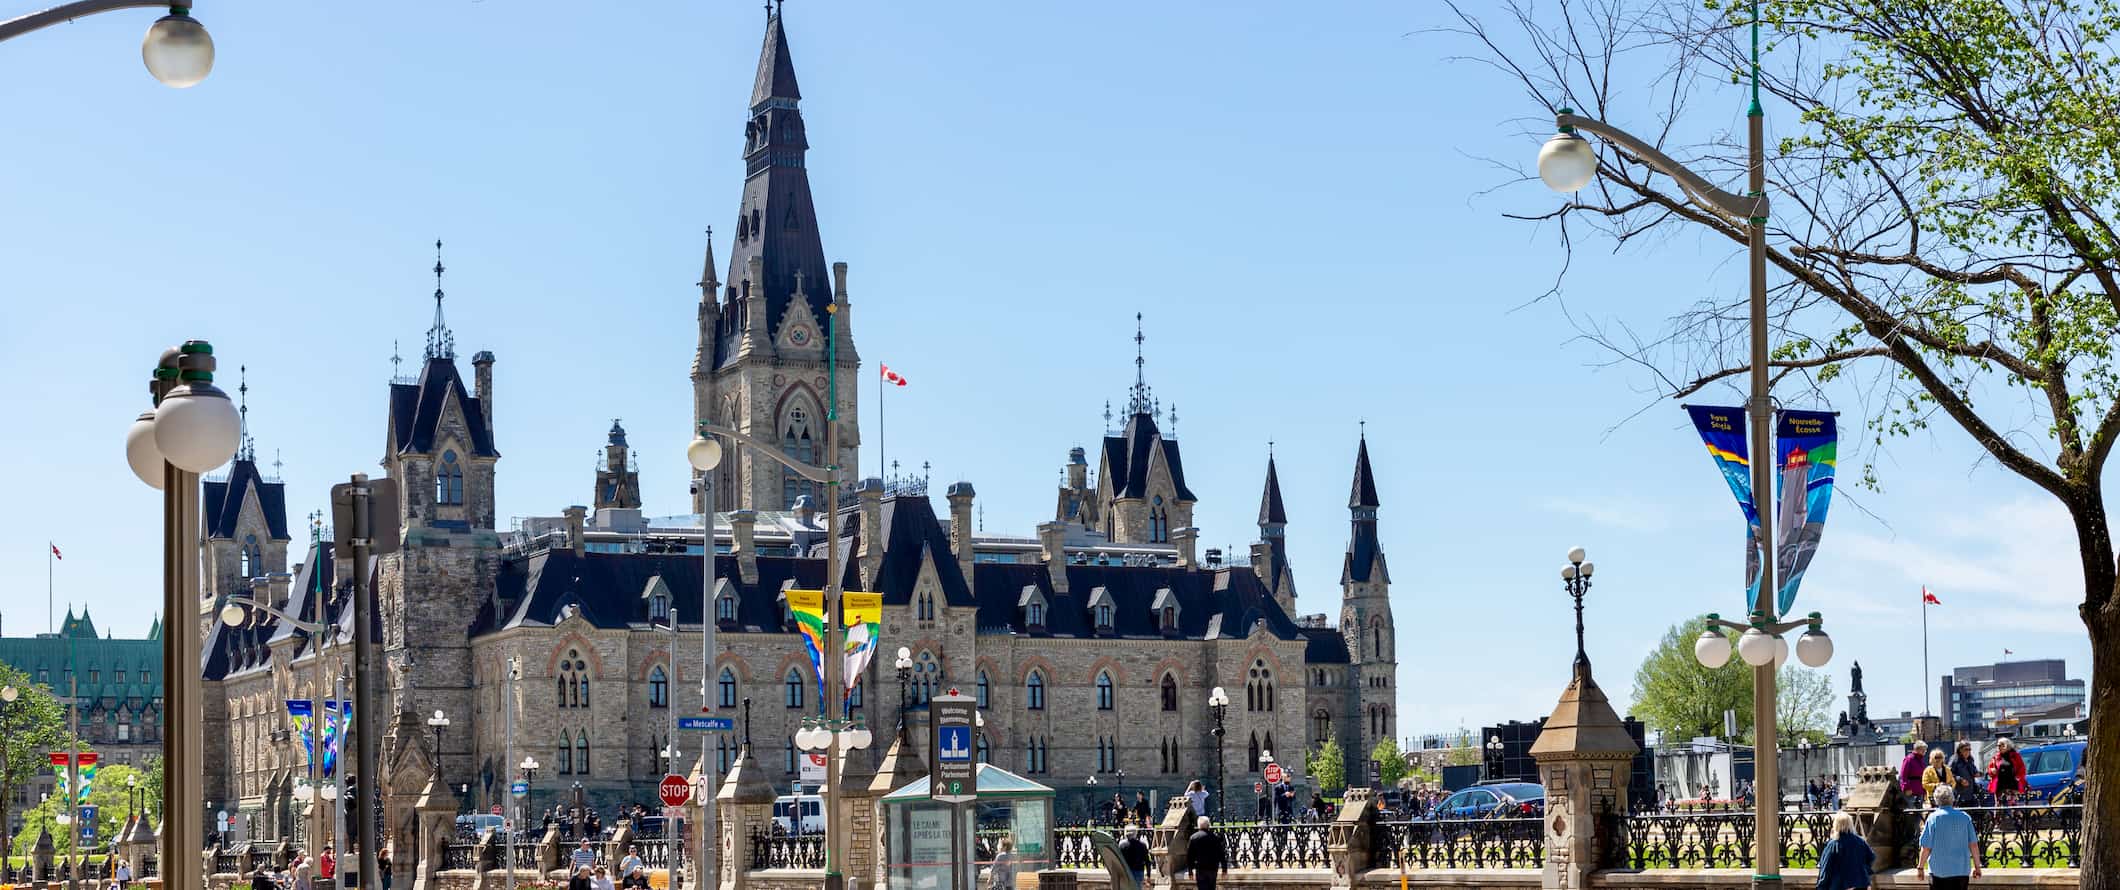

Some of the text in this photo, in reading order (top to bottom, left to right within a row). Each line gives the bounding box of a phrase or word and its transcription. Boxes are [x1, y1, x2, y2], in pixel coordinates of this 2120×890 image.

[692, 719, 719, 728] Metcalfe
[662, 784, 688, 797] STOP
[954, 783, 960, 793] P
